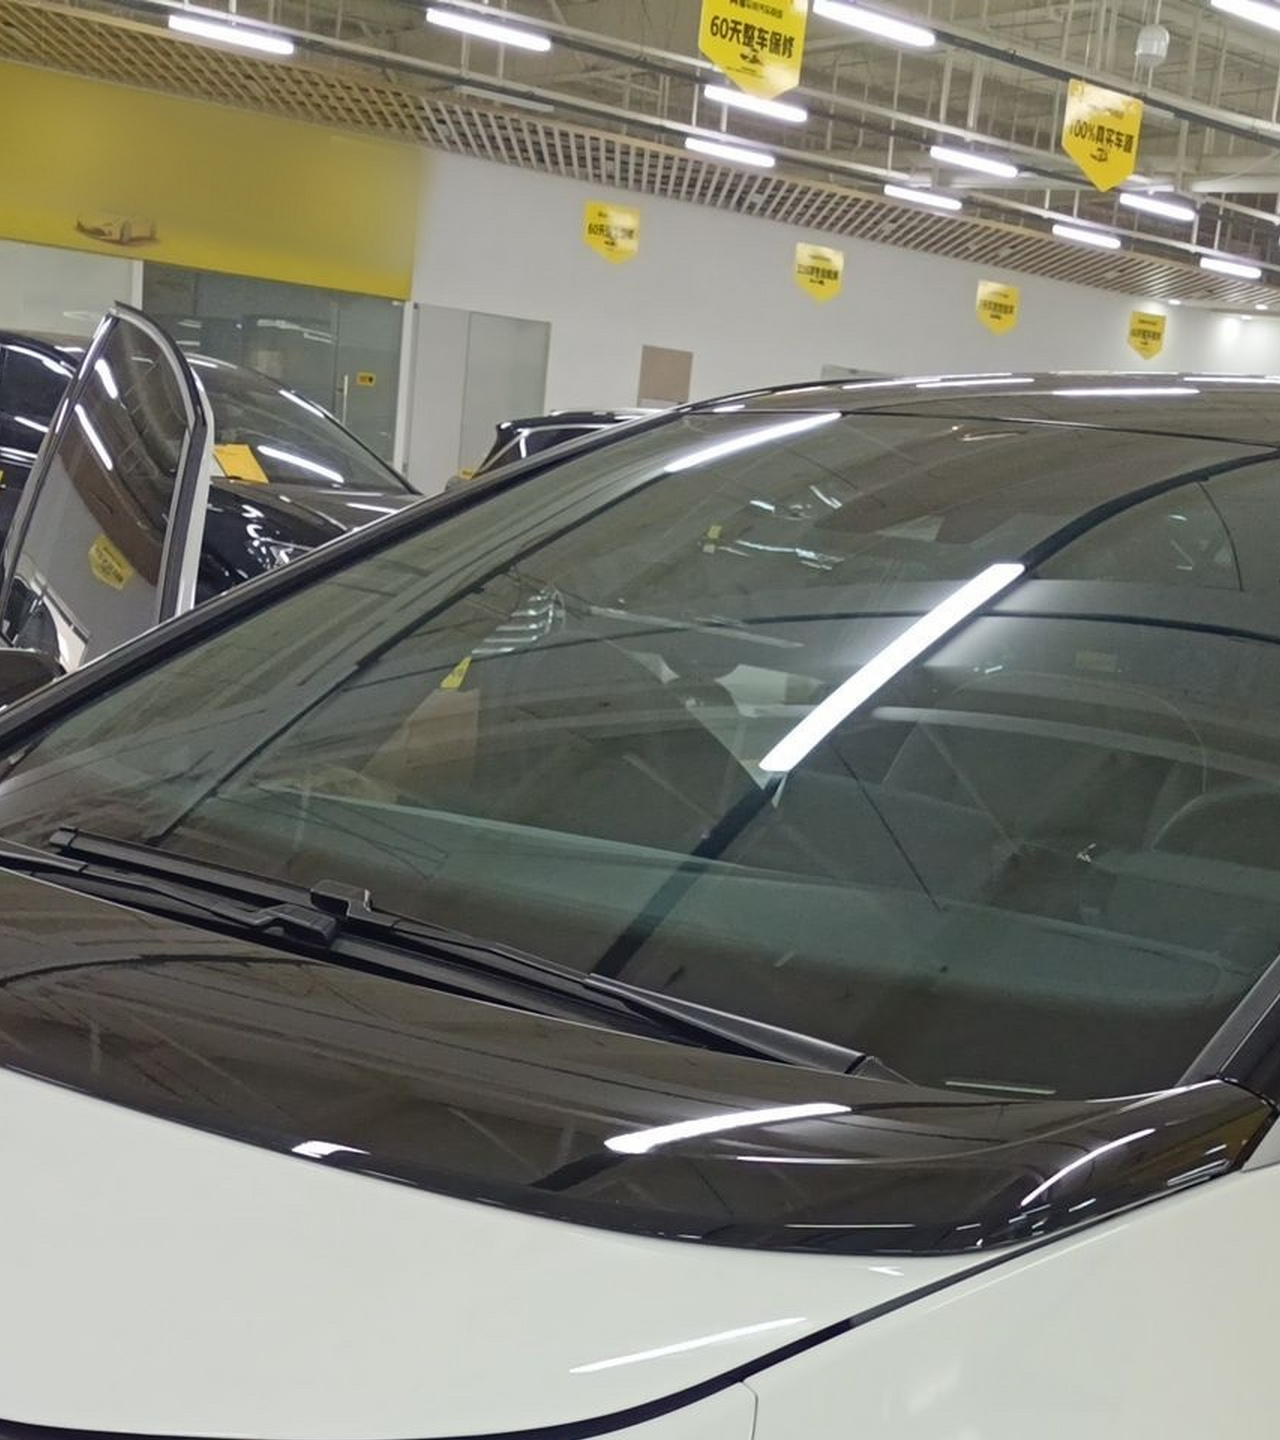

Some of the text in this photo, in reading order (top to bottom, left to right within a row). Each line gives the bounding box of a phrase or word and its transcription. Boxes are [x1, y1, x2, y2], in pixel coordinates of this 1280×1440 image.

[710, 15, 795, 59] 60天整车保修
